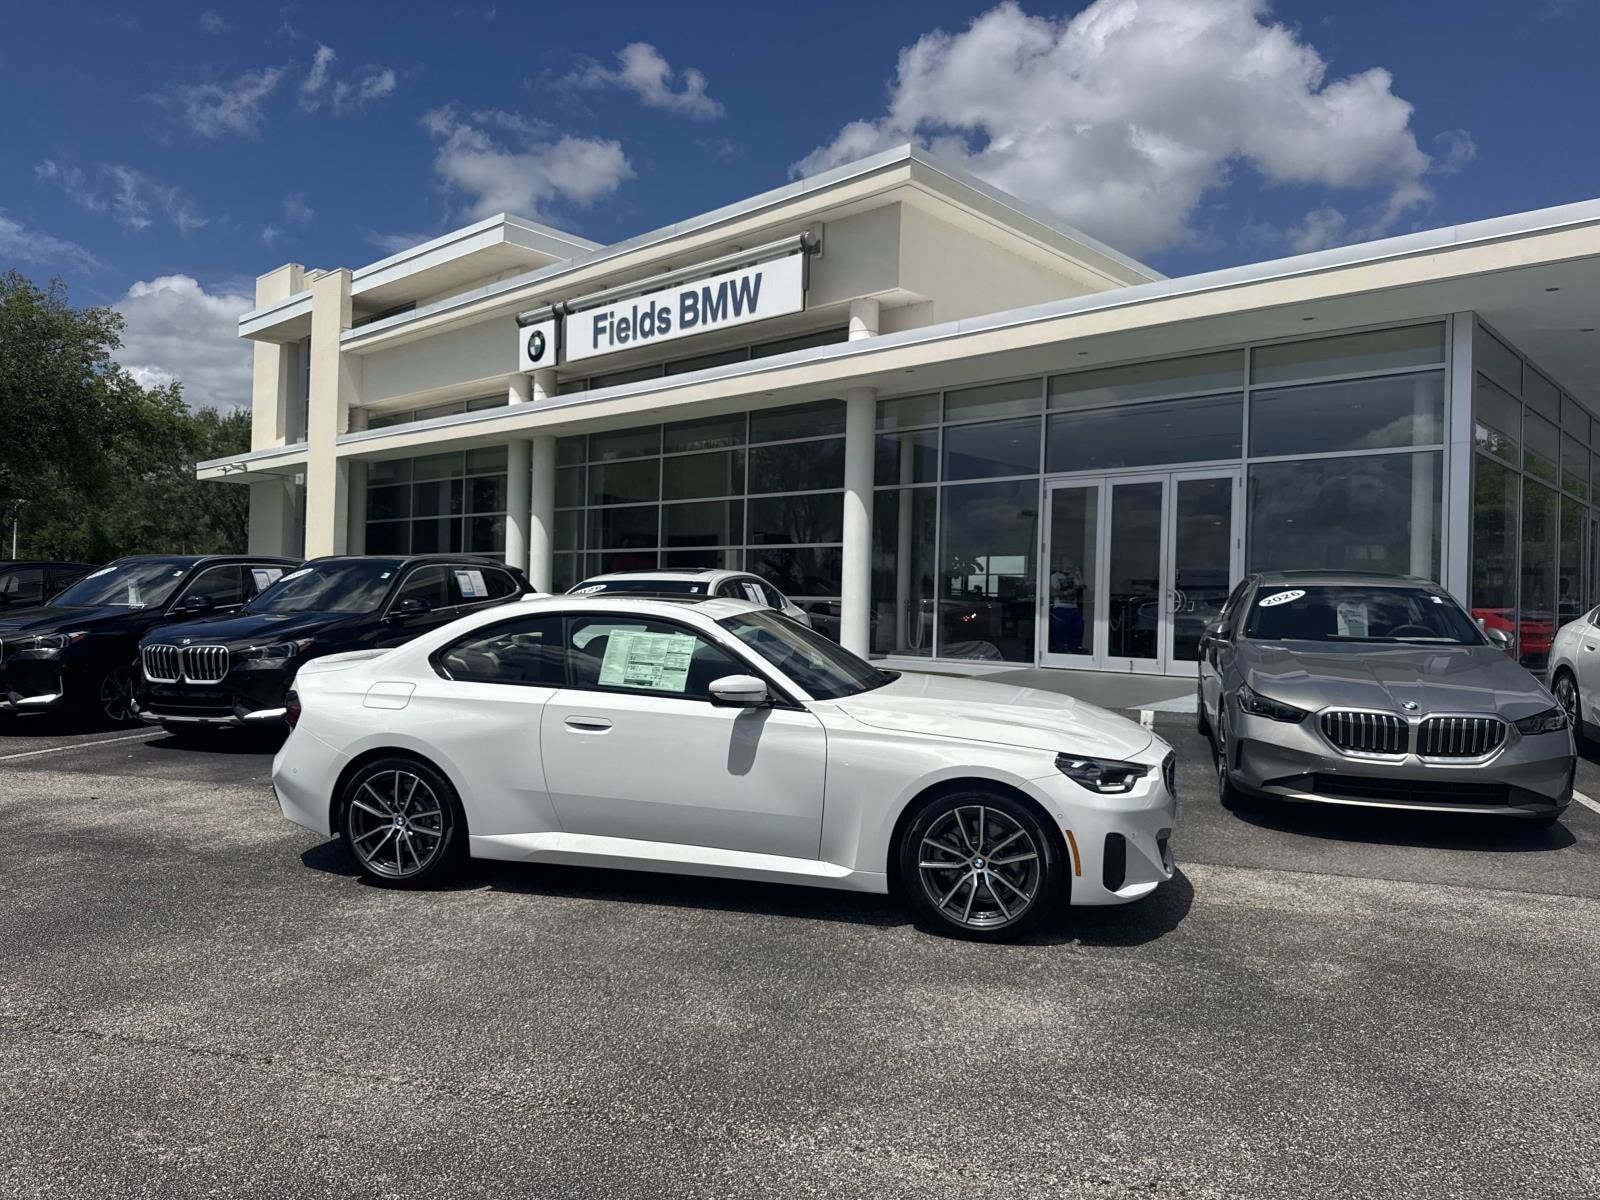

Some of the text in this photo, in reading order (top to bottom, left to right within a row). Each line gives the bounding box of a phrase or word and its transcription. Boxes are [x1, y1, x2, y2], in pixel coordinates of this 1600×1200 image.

[592, 300, 671, 348] Fields
[679, 272, 762, 330] BMW
[1263, 592, 1300, 605] 2026
